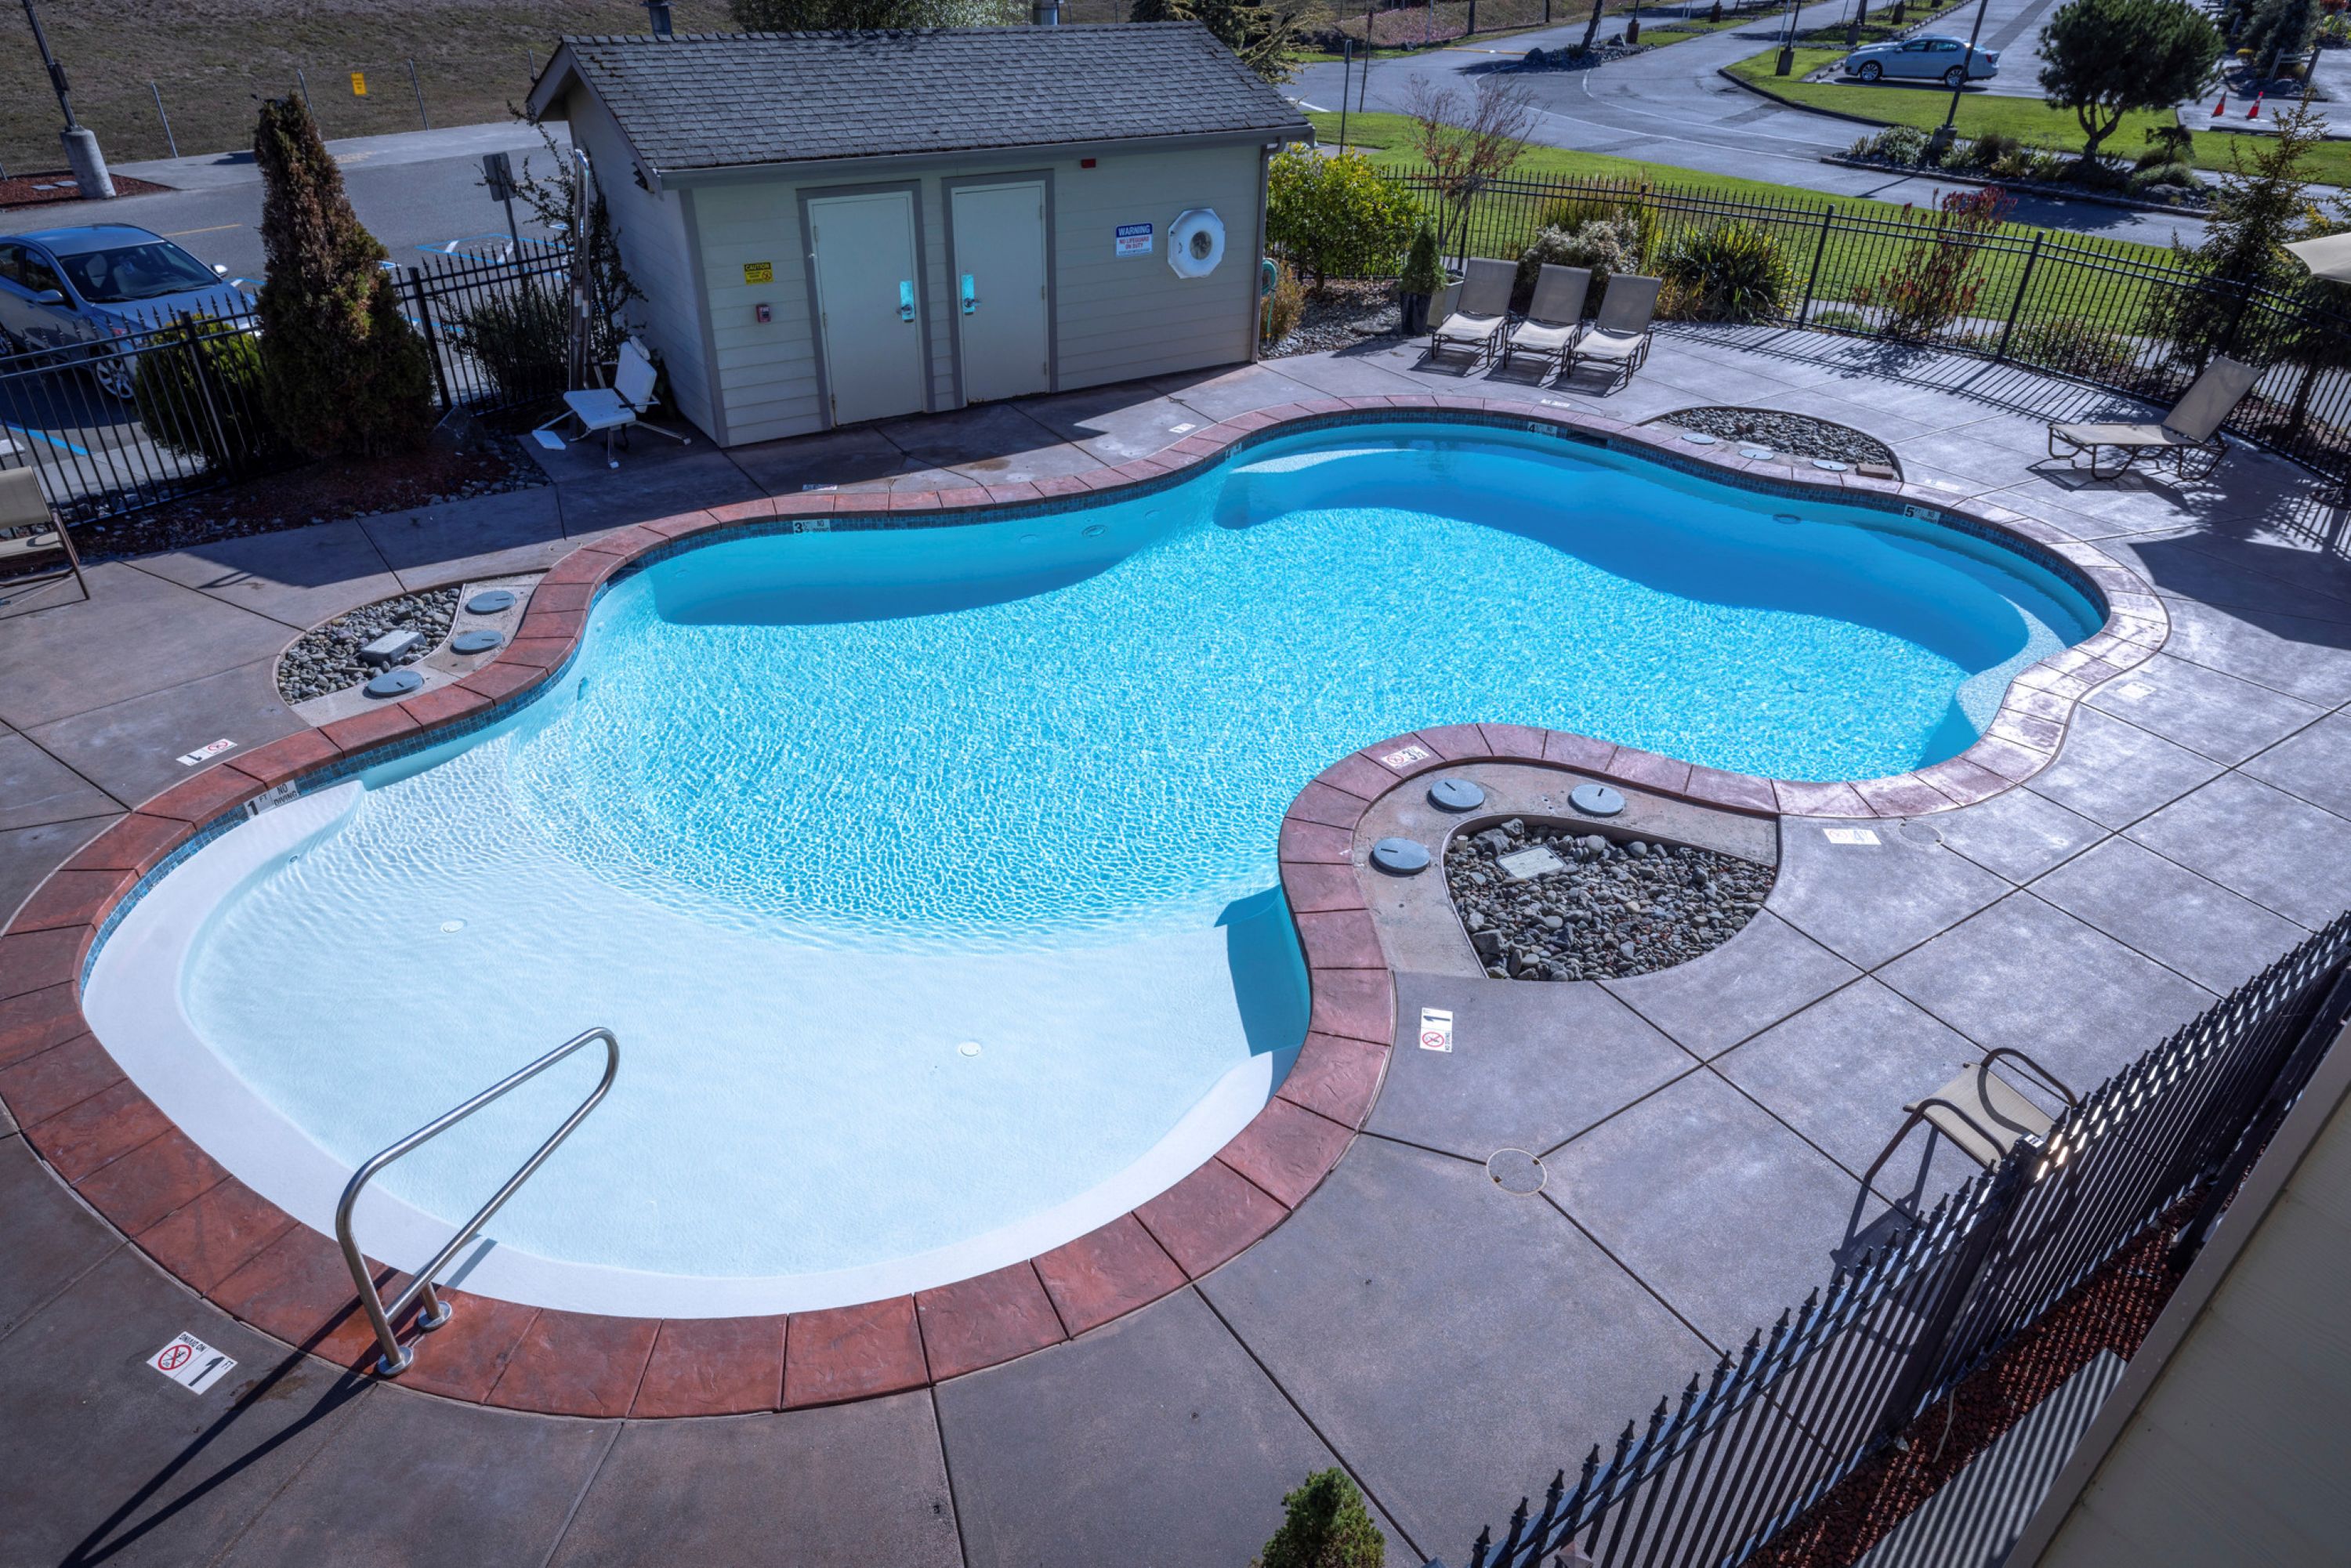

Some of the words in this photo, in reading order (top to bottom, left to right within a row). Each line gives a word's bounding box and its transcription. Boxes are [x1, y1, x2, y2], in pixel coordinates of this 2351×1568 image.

[1118, 225, 1150, 236] WARNING
[1529, 424, 1534, 433] 4
[1905, 506, 1914, 517] 5
[795, 522, 802, 533] 3
[277, 784, 288, 795] NO
[247, 800, 259, 816] 1
[259, 794, 267, 802] FT
[188, 1356, 225, 1387] 1
